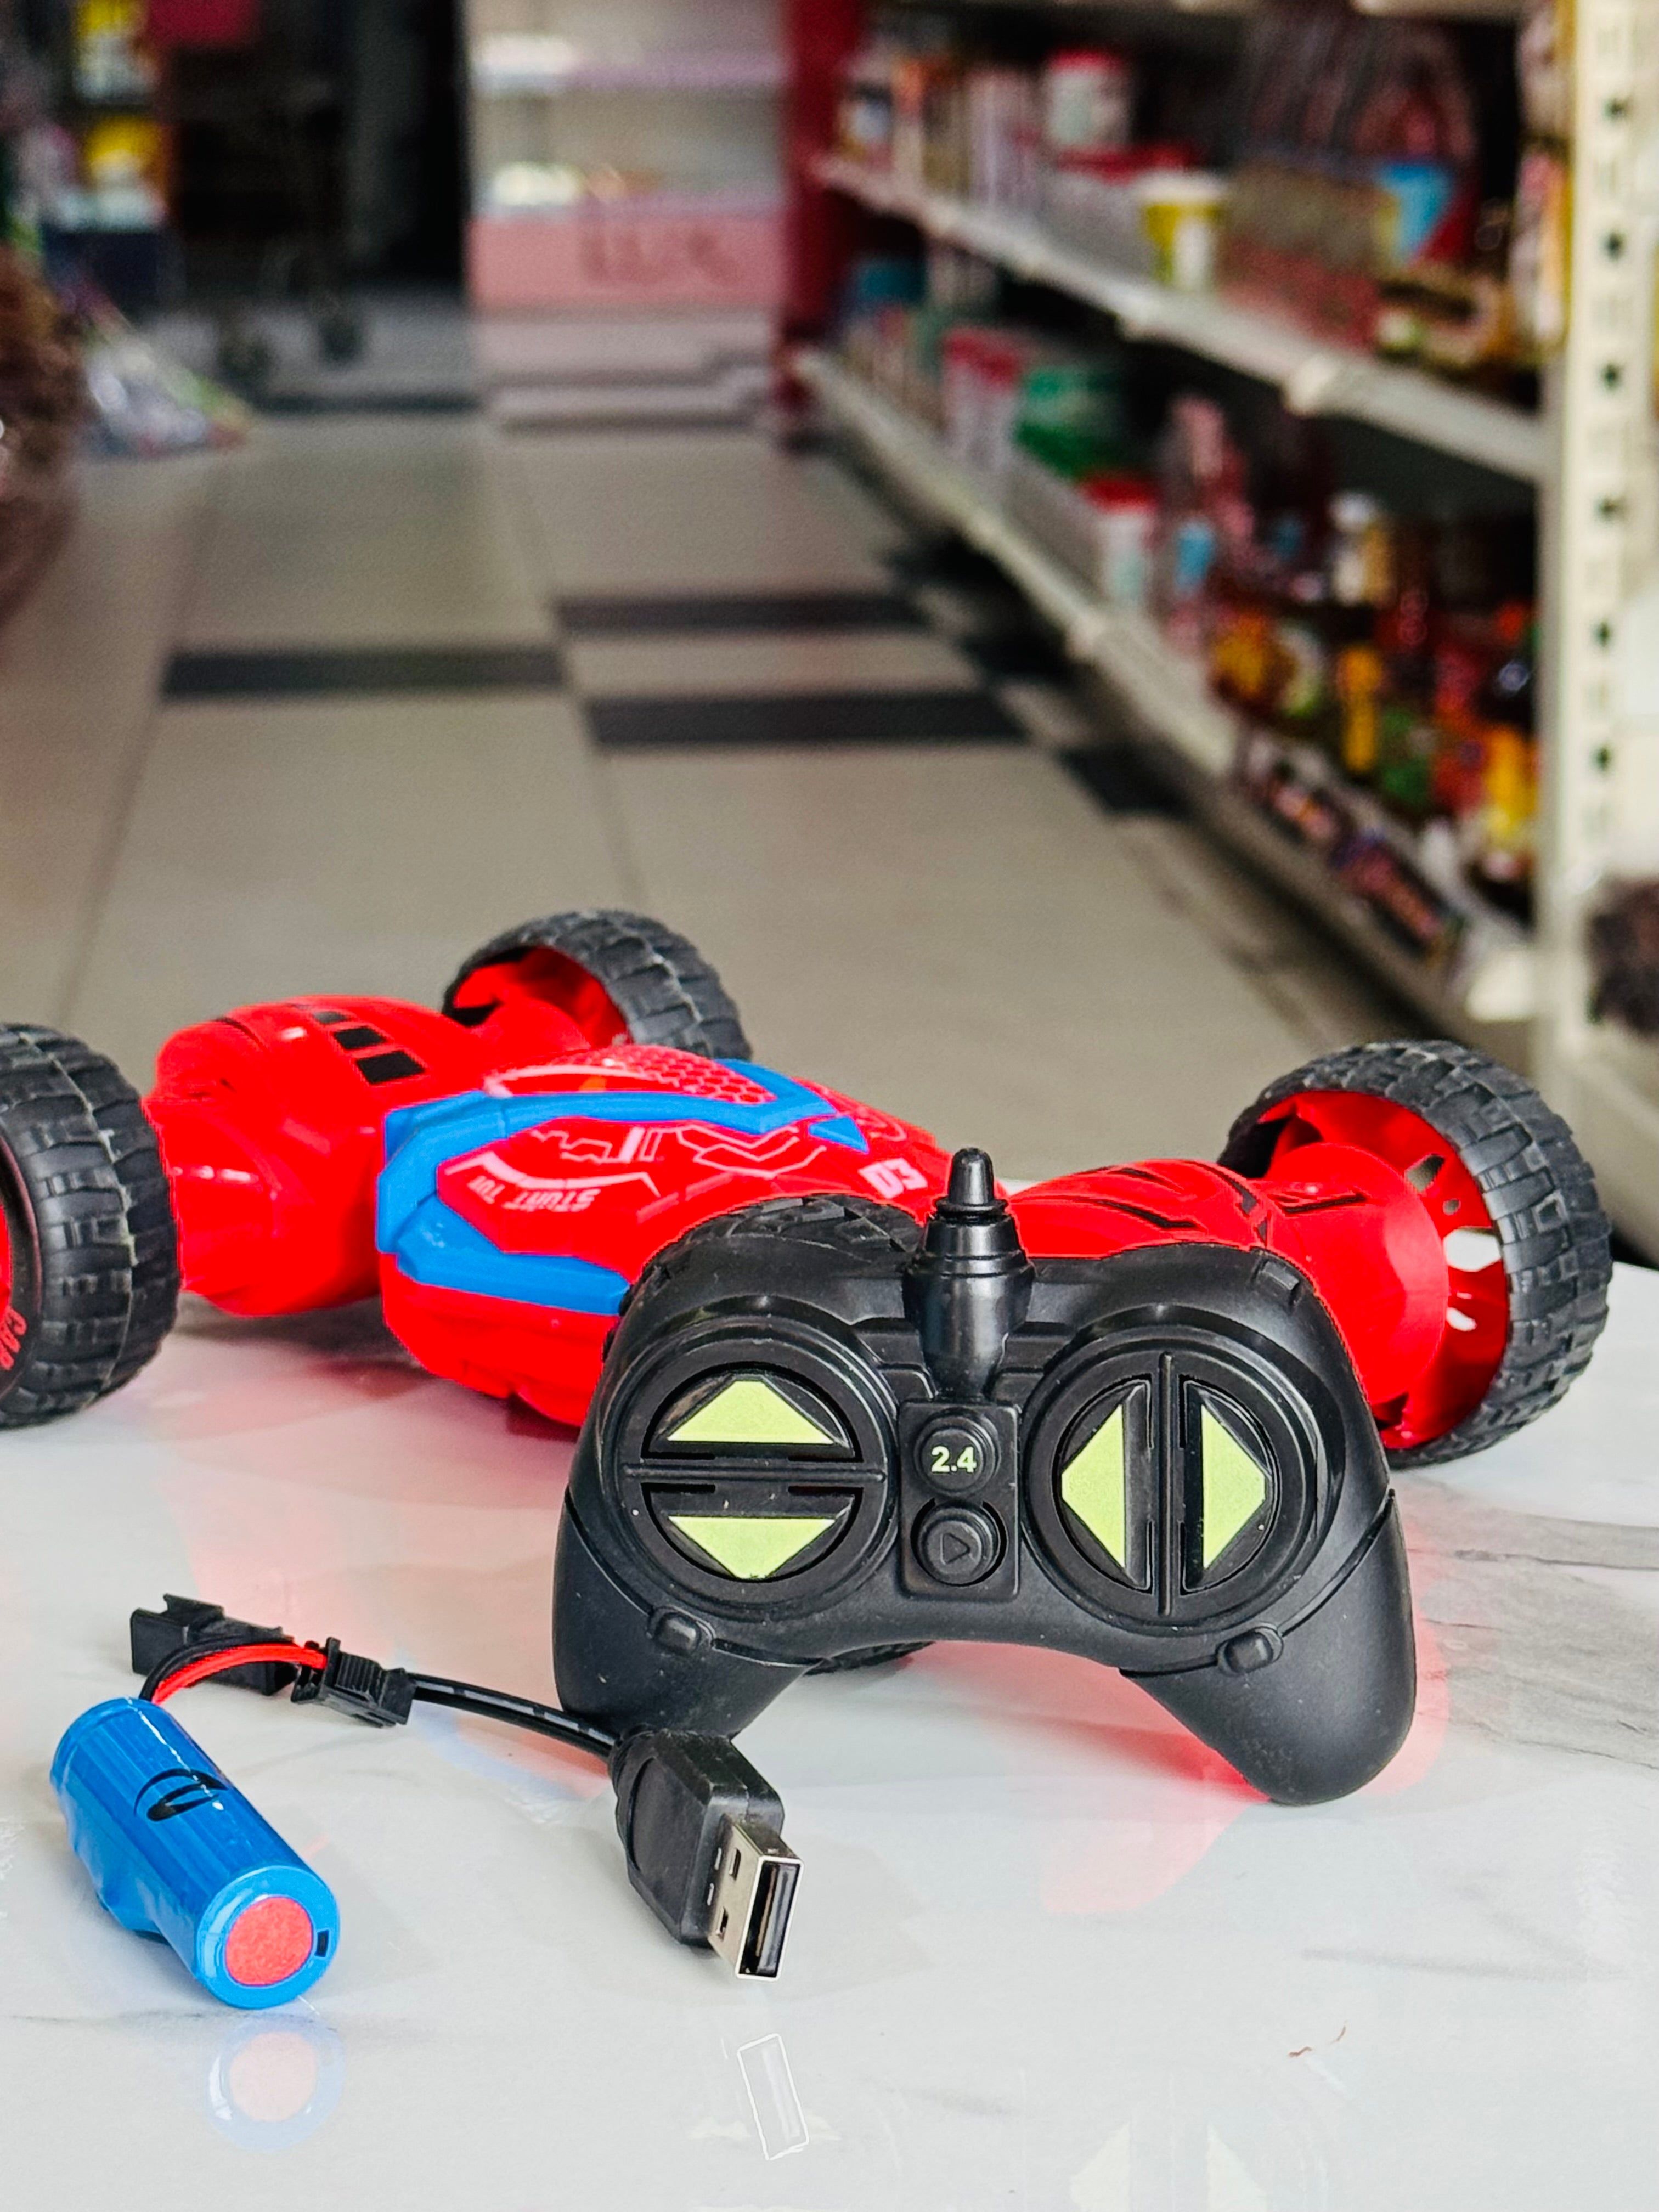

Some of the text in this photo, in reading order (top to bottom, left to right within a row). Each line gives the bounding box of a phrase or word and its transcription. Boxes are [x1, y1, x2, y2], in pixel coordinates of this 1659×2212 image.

[857, 1157, 928, 1199] 03
[501, 1188, 600, 1212] STUNT
[931, 1446, 977, 1473] 2.4
